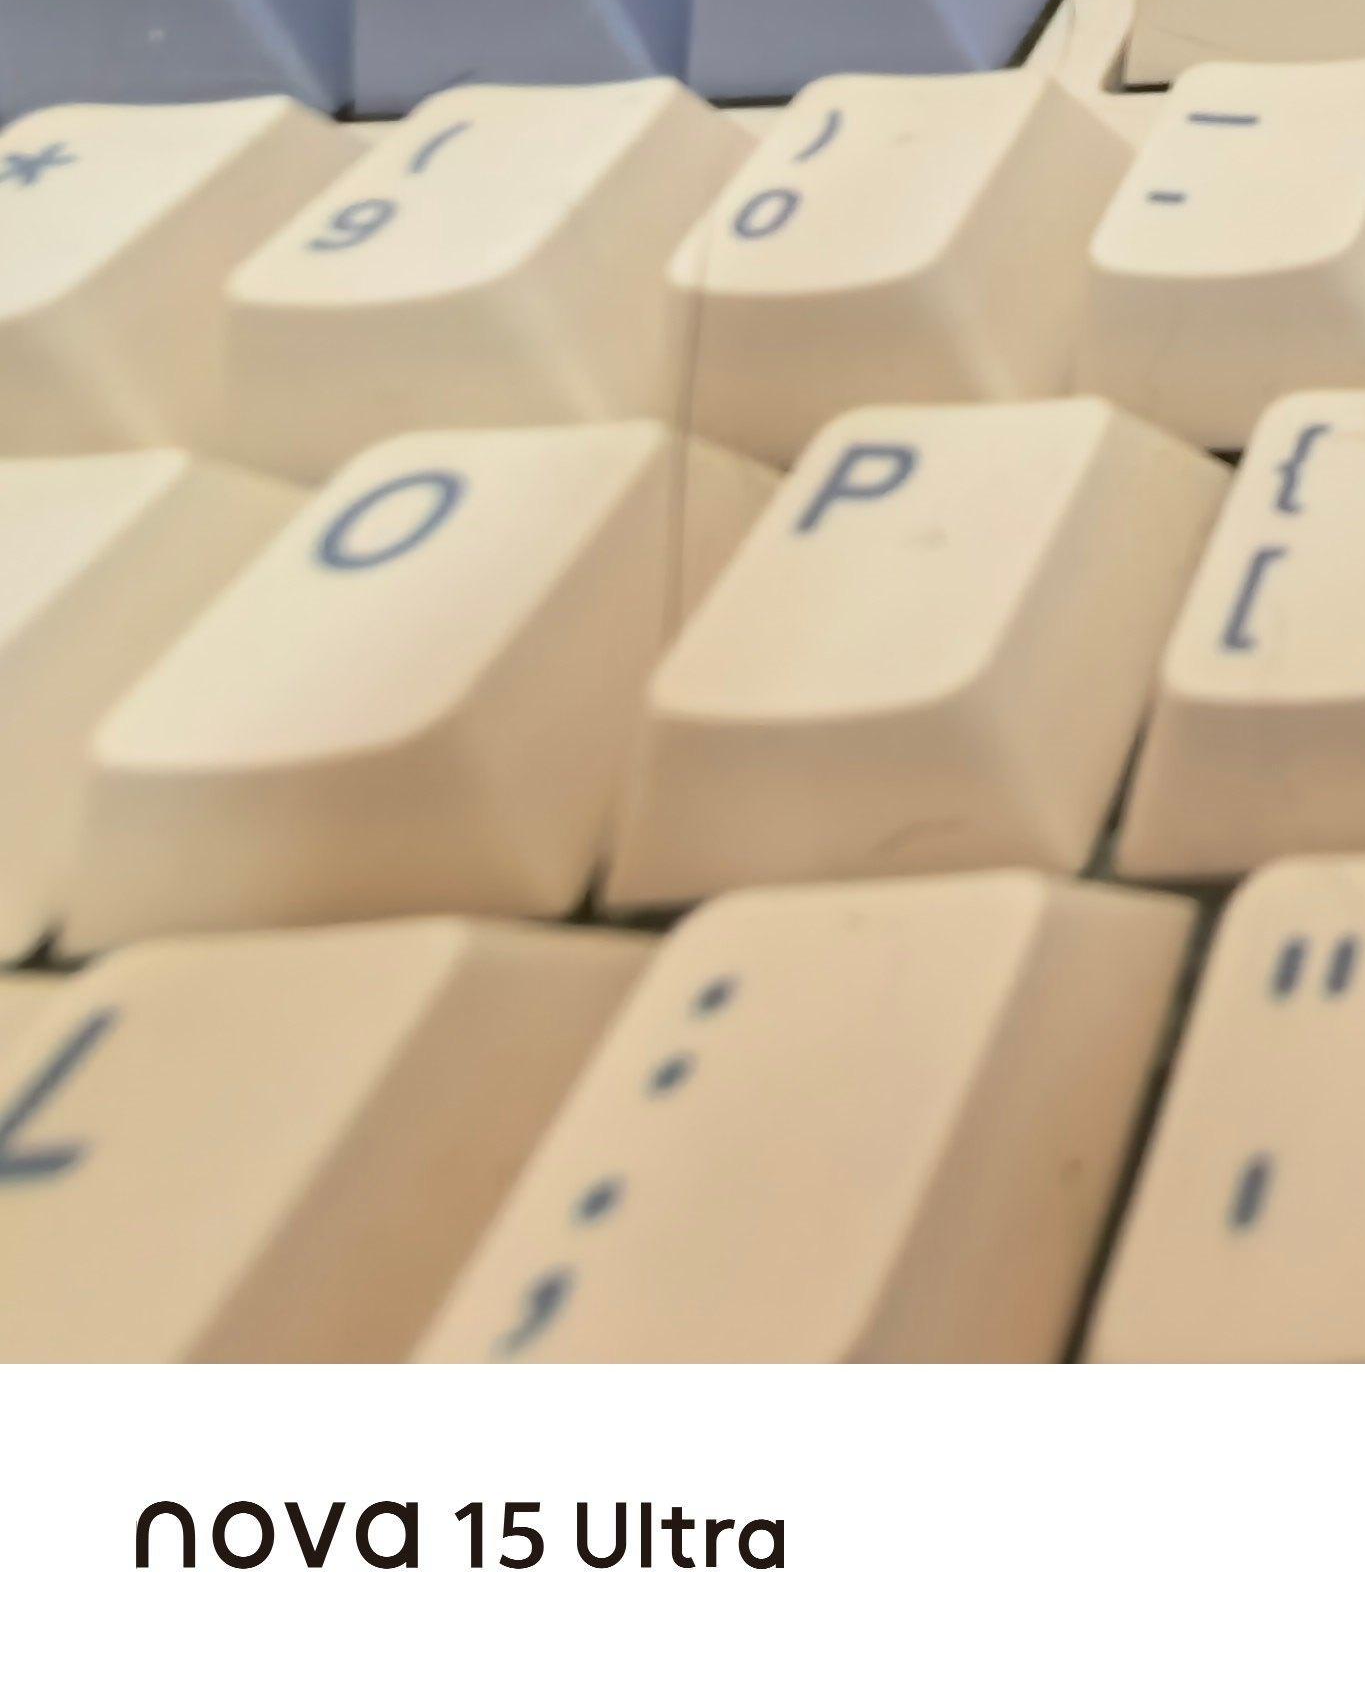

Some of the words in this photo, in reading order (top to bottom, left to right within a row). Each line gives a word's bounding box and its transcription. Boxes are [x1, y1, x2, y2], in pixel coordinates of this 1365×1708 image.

[303, 197, 396, 251] 9
[794, 444, 920, 534] P
[1218, 546, 1287, 652] [
